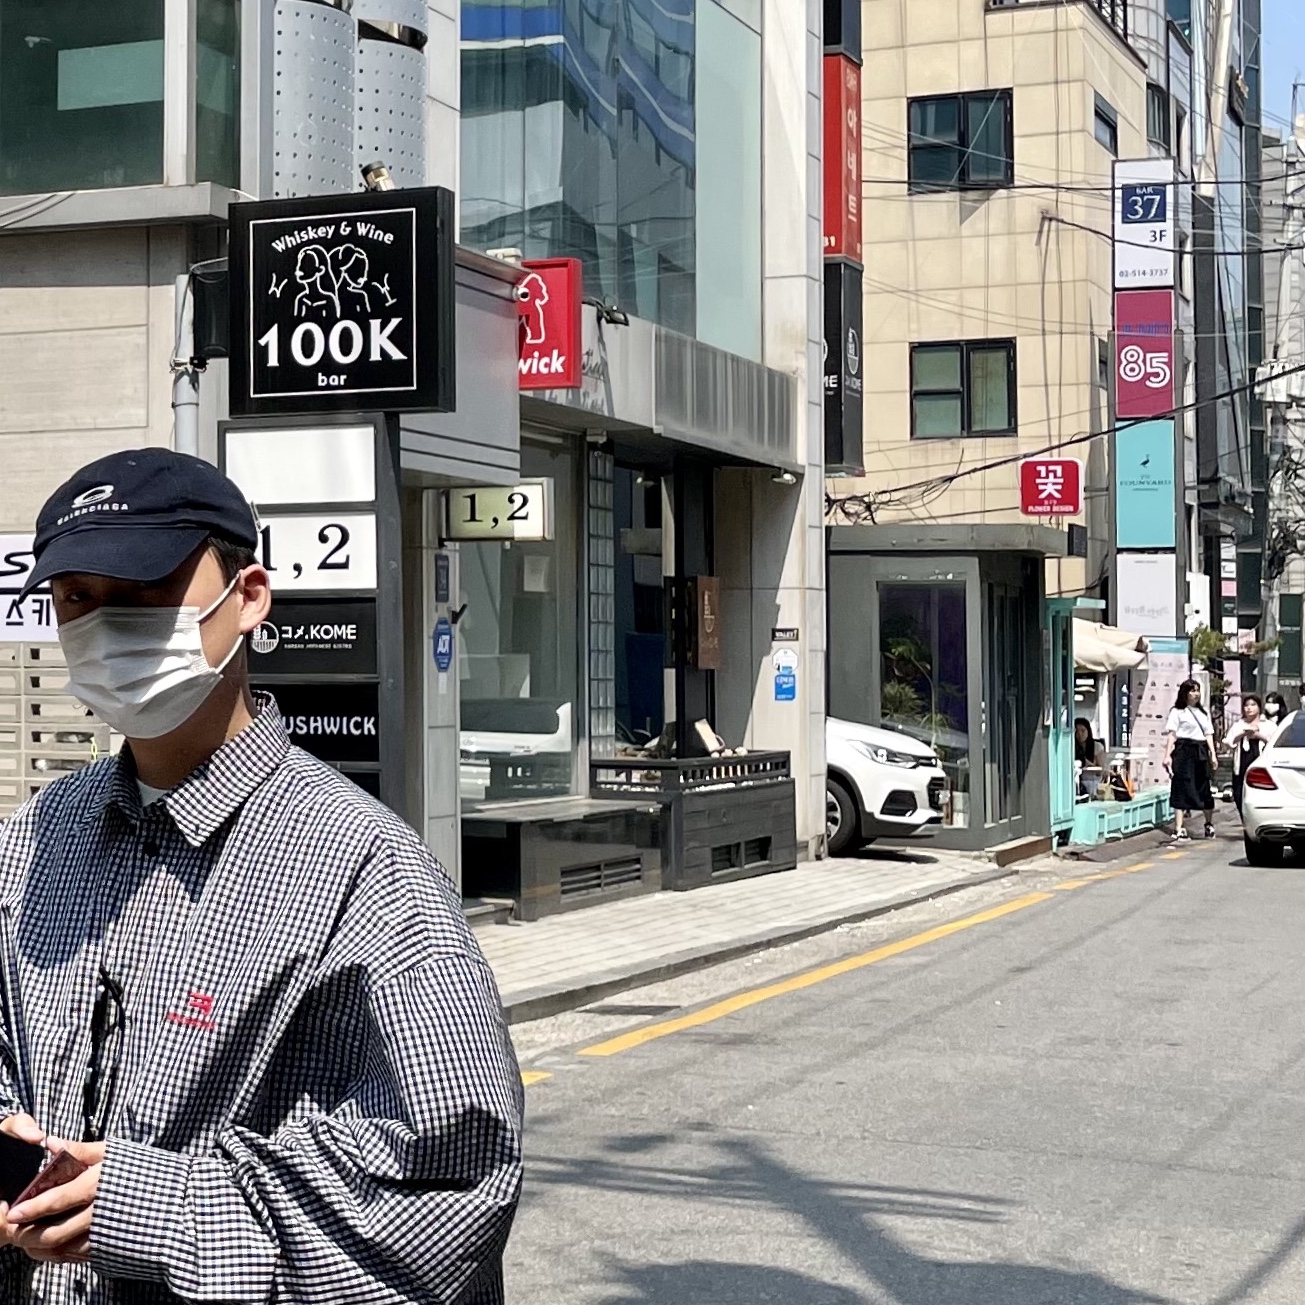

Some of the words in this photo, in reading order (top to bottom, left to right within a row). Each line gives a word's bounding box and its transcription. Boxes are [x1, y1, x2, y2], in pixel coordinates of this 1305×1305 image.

[1127, 195, 1161, 219] 37
[271, 224, 336, 253] Whiskey
[339, 221, 352, 236] &
[356, 222, 394, 245] Wine
[1149, 230, 1167, 242] 3F
[257, 317, 408, 367] 100K
[317, 373, 347, 386] bar
[1119, 345, 1171, 388] 85
[1035, 465, 1064, 499] 꽃
[280, 716, 376, 736] USHWICK
